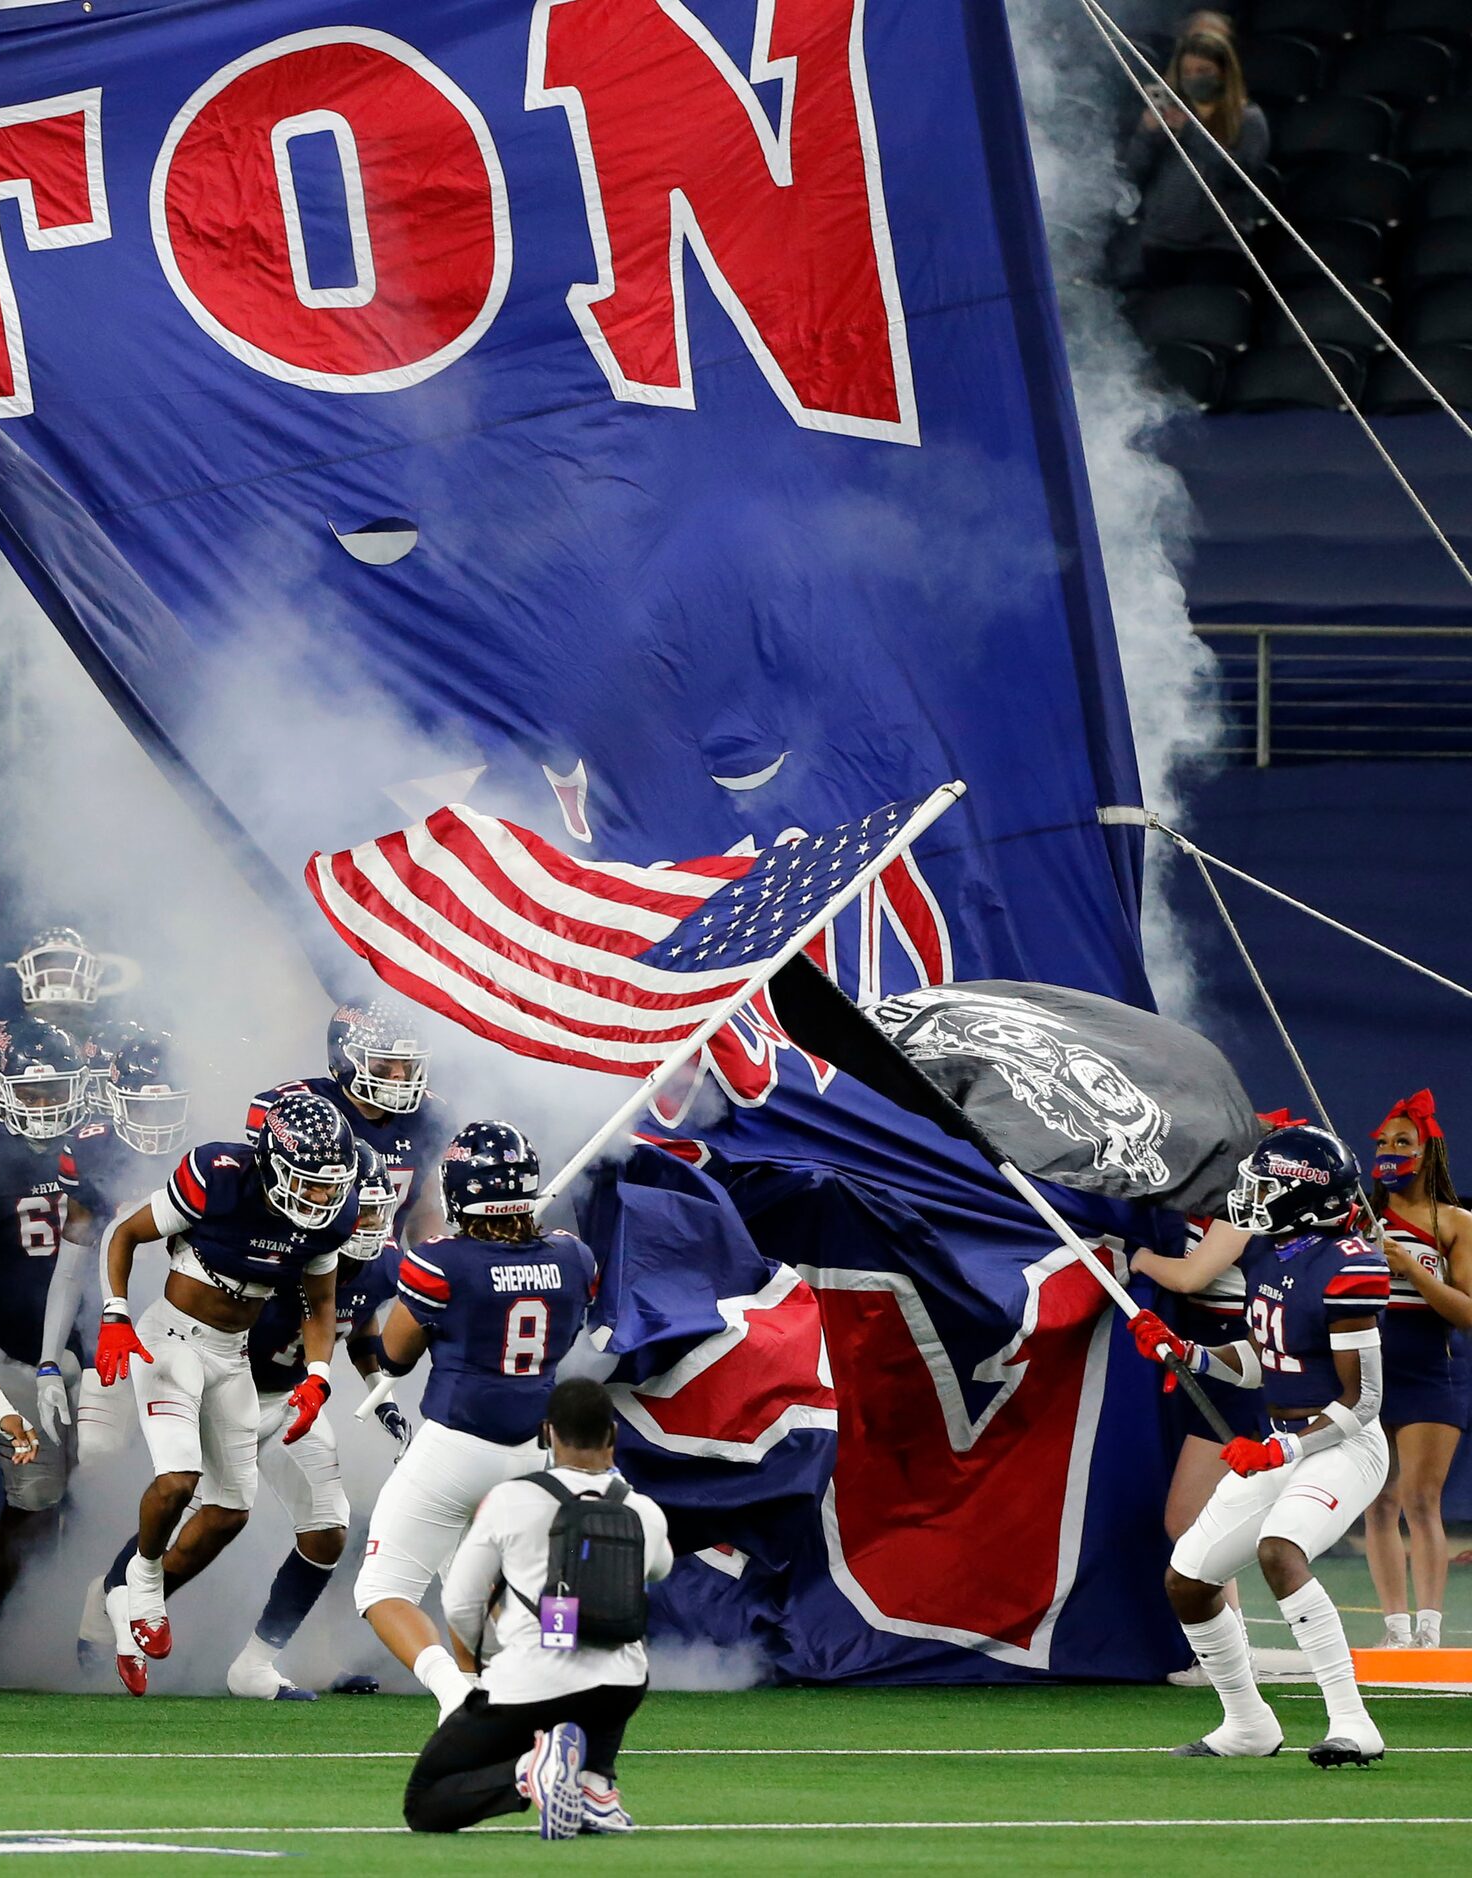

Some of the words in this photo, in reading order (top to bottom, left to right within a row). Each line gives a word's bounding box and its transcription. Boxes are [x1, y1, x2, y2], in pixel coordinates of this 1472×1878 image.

[212, 1153, 241, 1169] 4
[1267, 1153, 1330, 1186] Raiders
[38, 1182, 64, 1195] RYA
[484, 1203, 530, 1215] Riddell
[257, 1240, 286, 1253] RYAN
[1335, 1236, 1373, 1257] 21
[490, 1263, 562, 1293] SHEPPARD
[500, 1297, 551, 1377] 8
[1245, 1297, 1306, 1374] 21
[553, 1612, 565, 1632] 3
